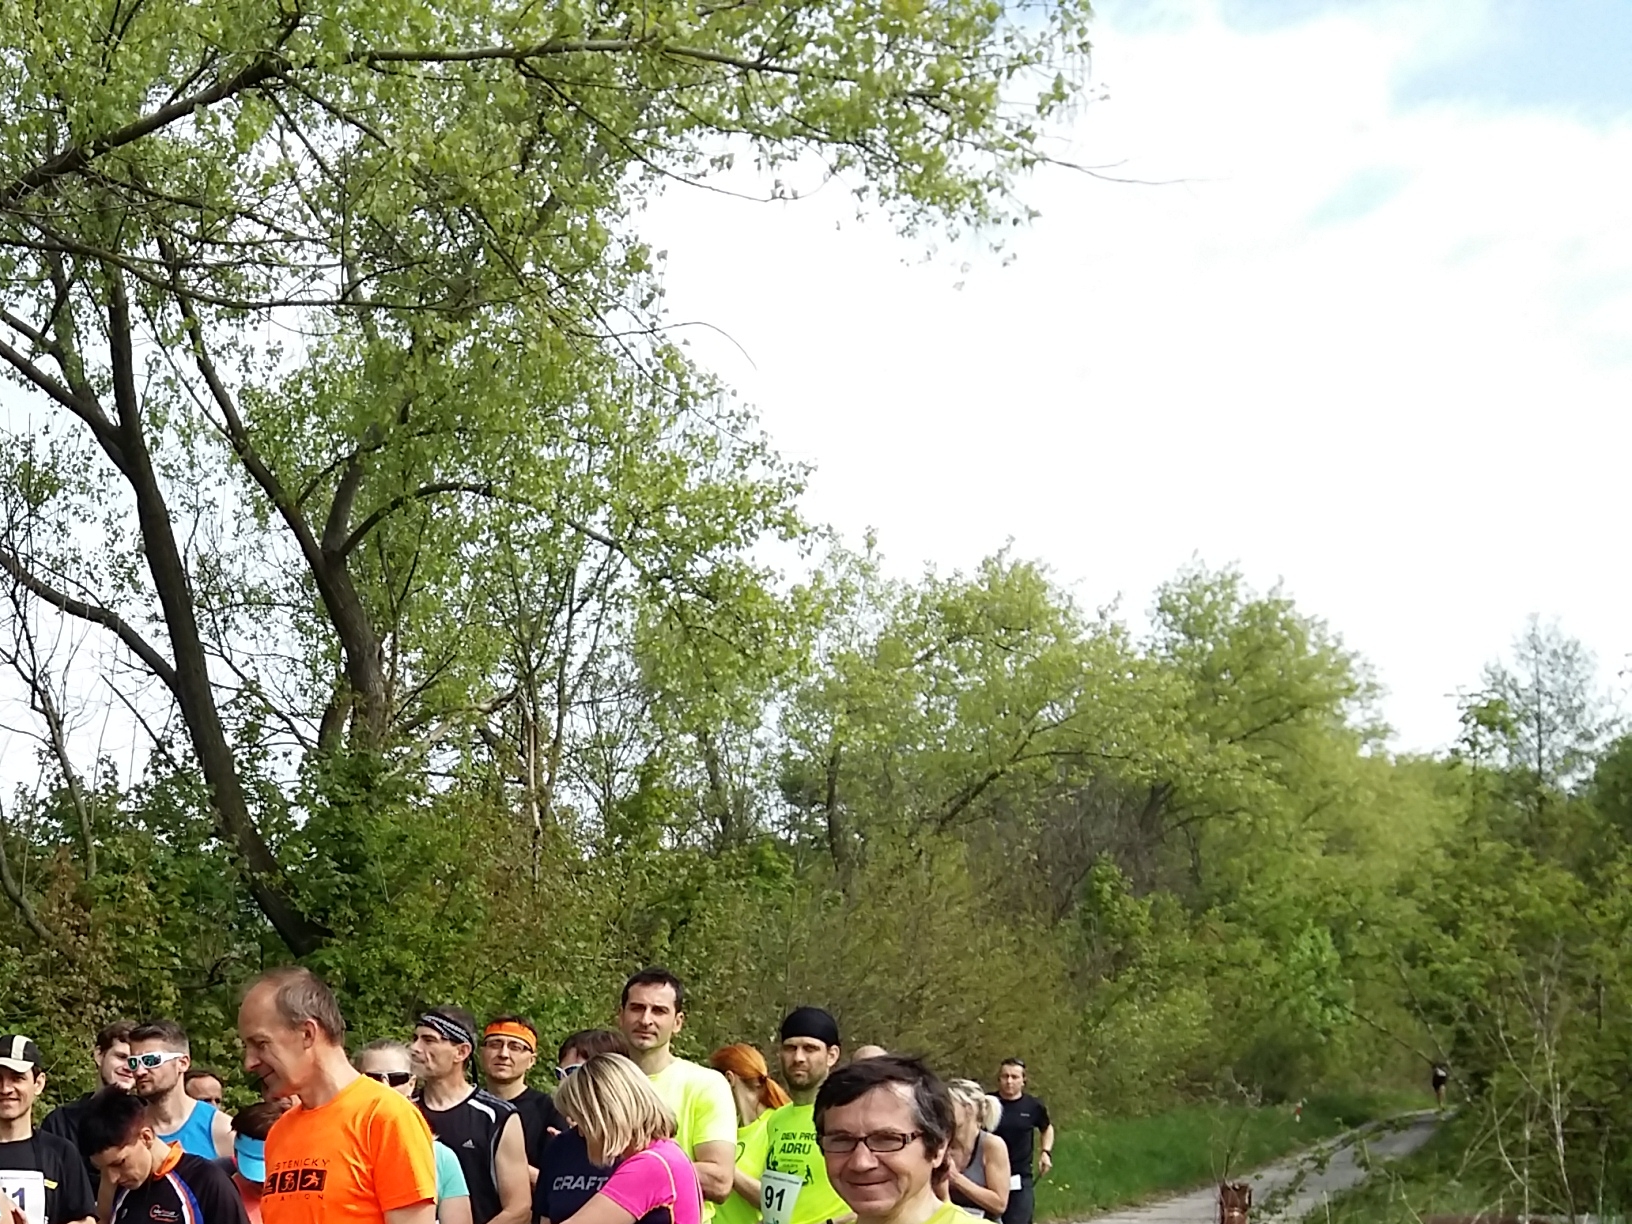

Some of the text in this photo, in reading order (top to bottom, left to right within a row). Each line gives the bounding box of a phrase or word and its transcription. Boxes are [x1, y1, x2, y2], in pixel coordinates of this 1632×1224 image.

[779, 1143, 811, 1155] ADRU
[552, 1175, 609, 1191] CRAFT
[764, 1185, 786, 1211] 91
